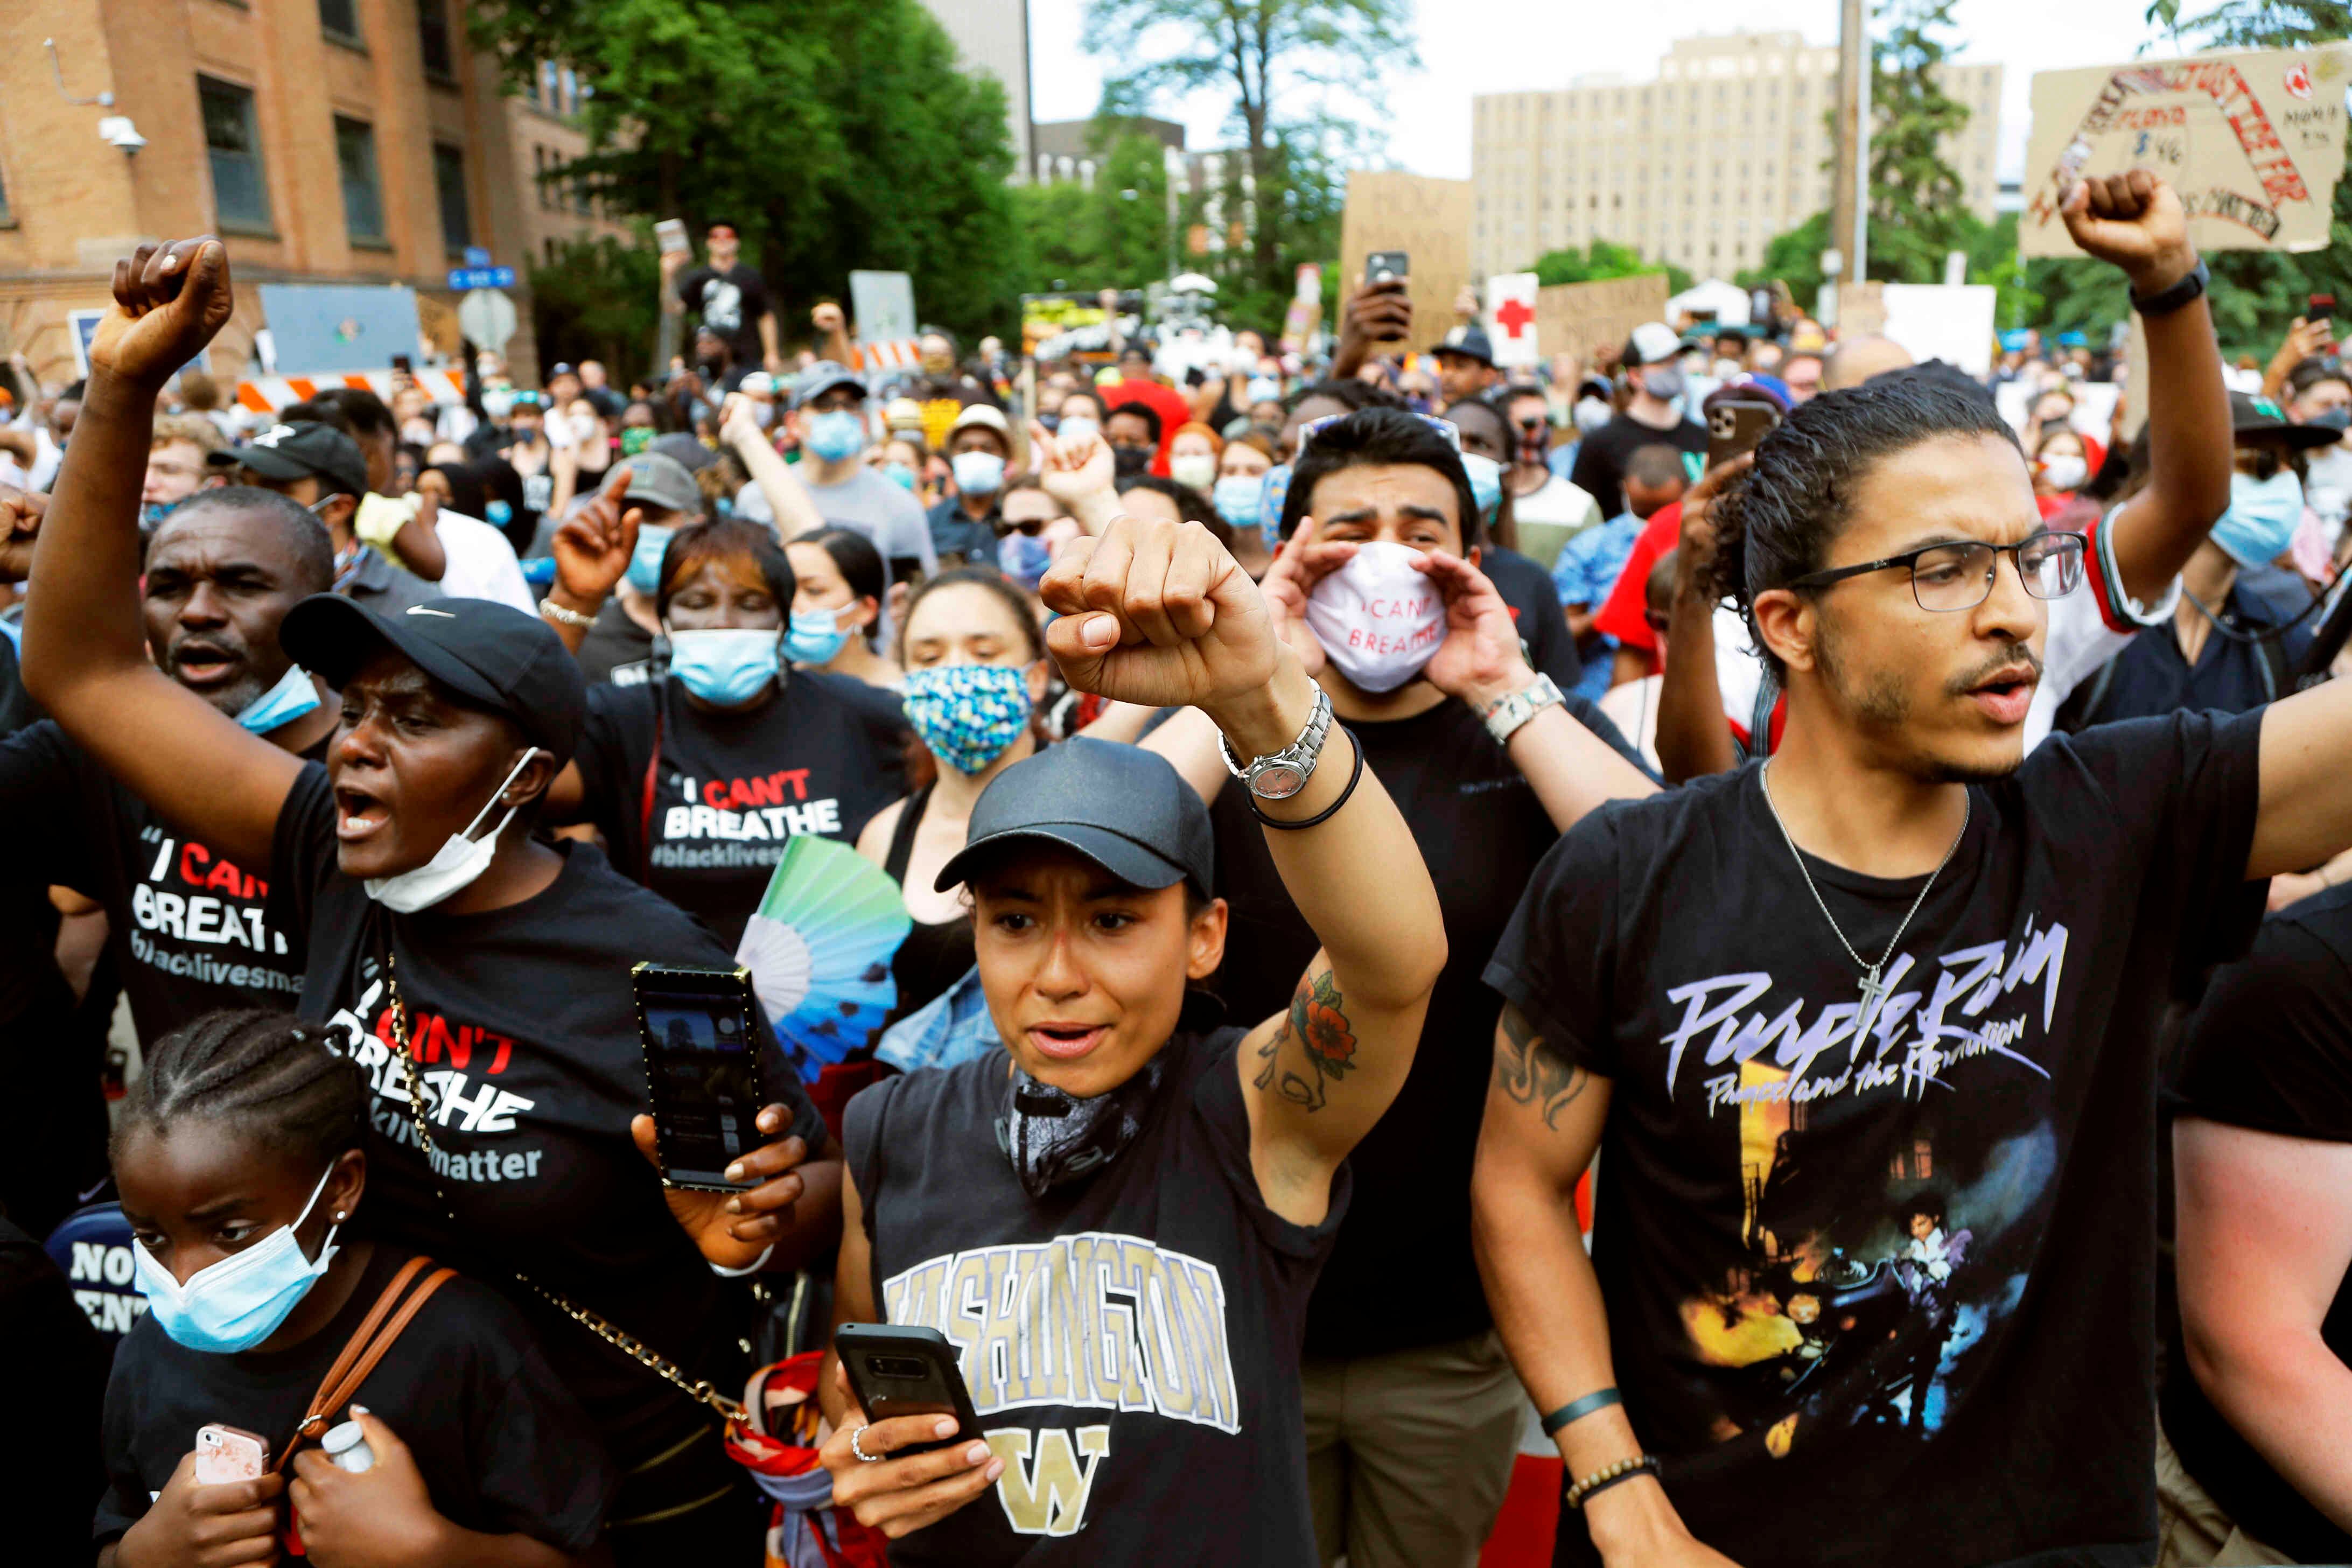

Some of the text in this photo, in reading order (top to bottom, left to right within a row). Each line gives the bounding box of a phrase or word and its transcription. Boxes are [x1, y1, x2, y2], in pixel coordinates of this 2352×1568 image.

[703, 768, 810, 809] CAN'T
[664, 798, 842, 841] BREATHE
[1660, 952, 1923, 1103] Purple
[1791, 1065, 1853, 1103] and
[1855, 1058, 1899, 1097] the
[984, 1426, 1110, 1537] W
